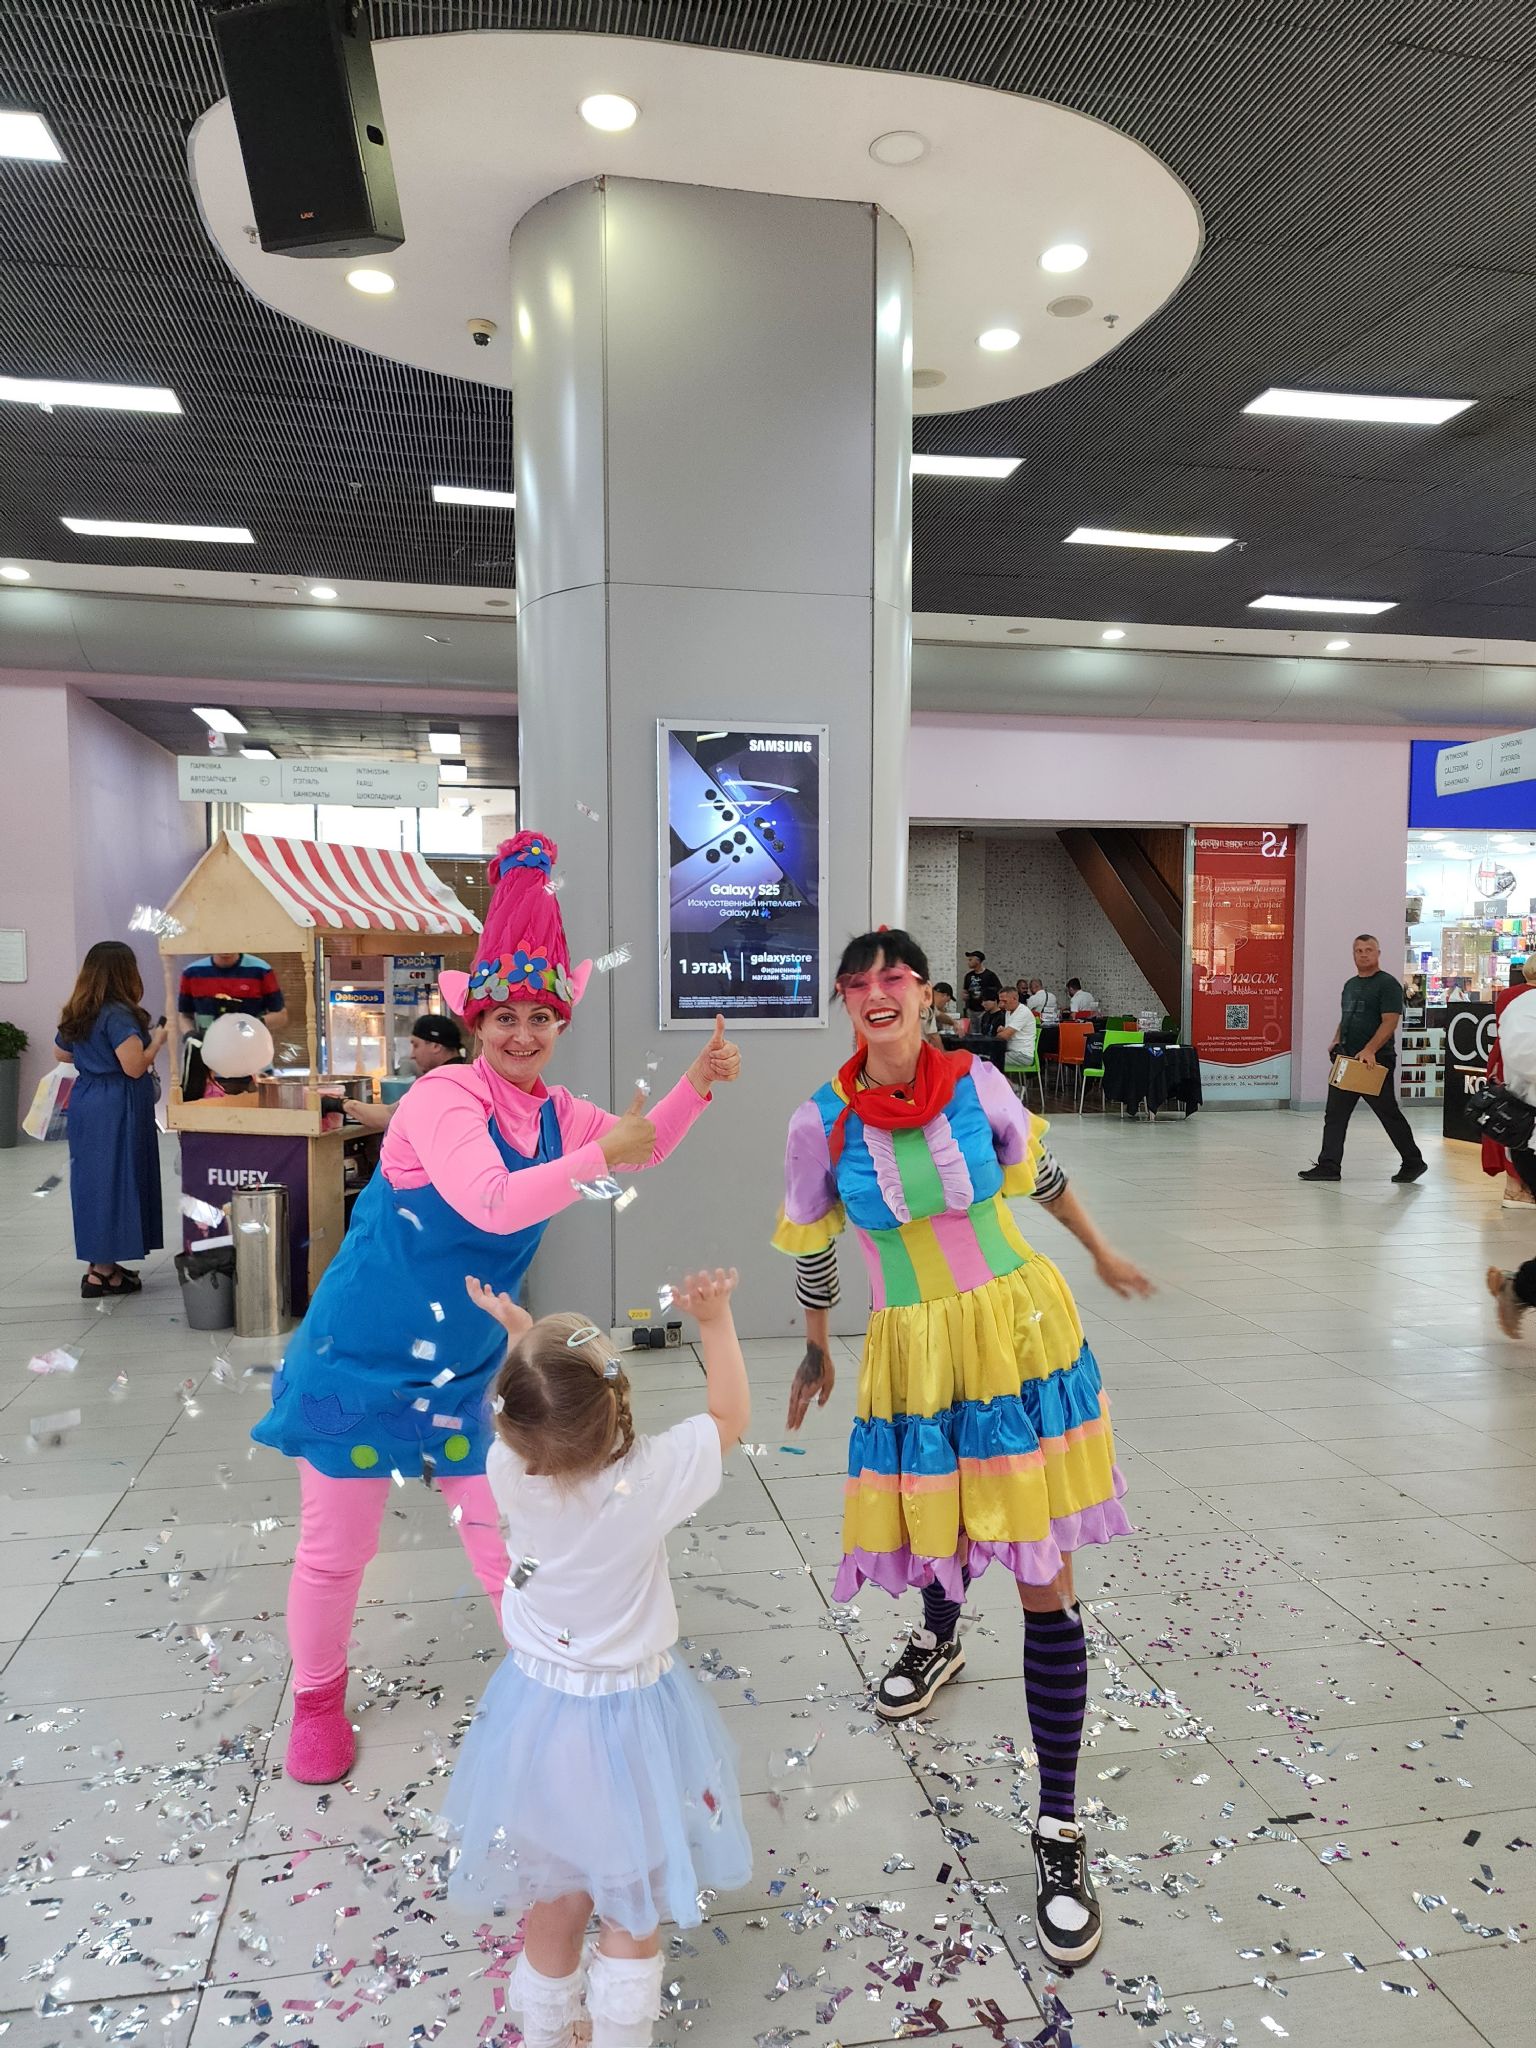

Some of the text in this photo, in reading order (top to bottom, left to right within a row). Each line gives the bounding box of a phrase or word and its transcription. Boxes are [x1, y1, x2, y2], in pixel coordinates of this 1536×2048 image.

[749, 739, 812, 753] SAMSUNG
[190, 762, 222, 770] ПАРКОВКА
[292, 765, 329, 773] CALZEDONIA
[190, 775, 237, 783] АВТОЗАПЧАСТИ
[191, 788, 228, 796] ХИМЧИСТКА
[356, 792, 402, 801] ШОКОЛАДНИЦА
[710, 883, 780, 899] Galaxy S25
[687, 899, 756, 909] Искусственный
[1235, 896, 1251, 908] для
[1253, 894, 1282, 908] детей
[719, 908, 759, 919] Galaxy AI
[397, 957, 437, 966] POPCORN
[750, 951, 813, 965] galaxystore
[679, 959, 732, 974] 1 этаж
[760, 966, 802, 974] Фирменный
[780, 973, 811, 982] Samsung
[1223, 973, 1279, 984] этаж
[208, 1168, 269, 1187] FLUFFY
